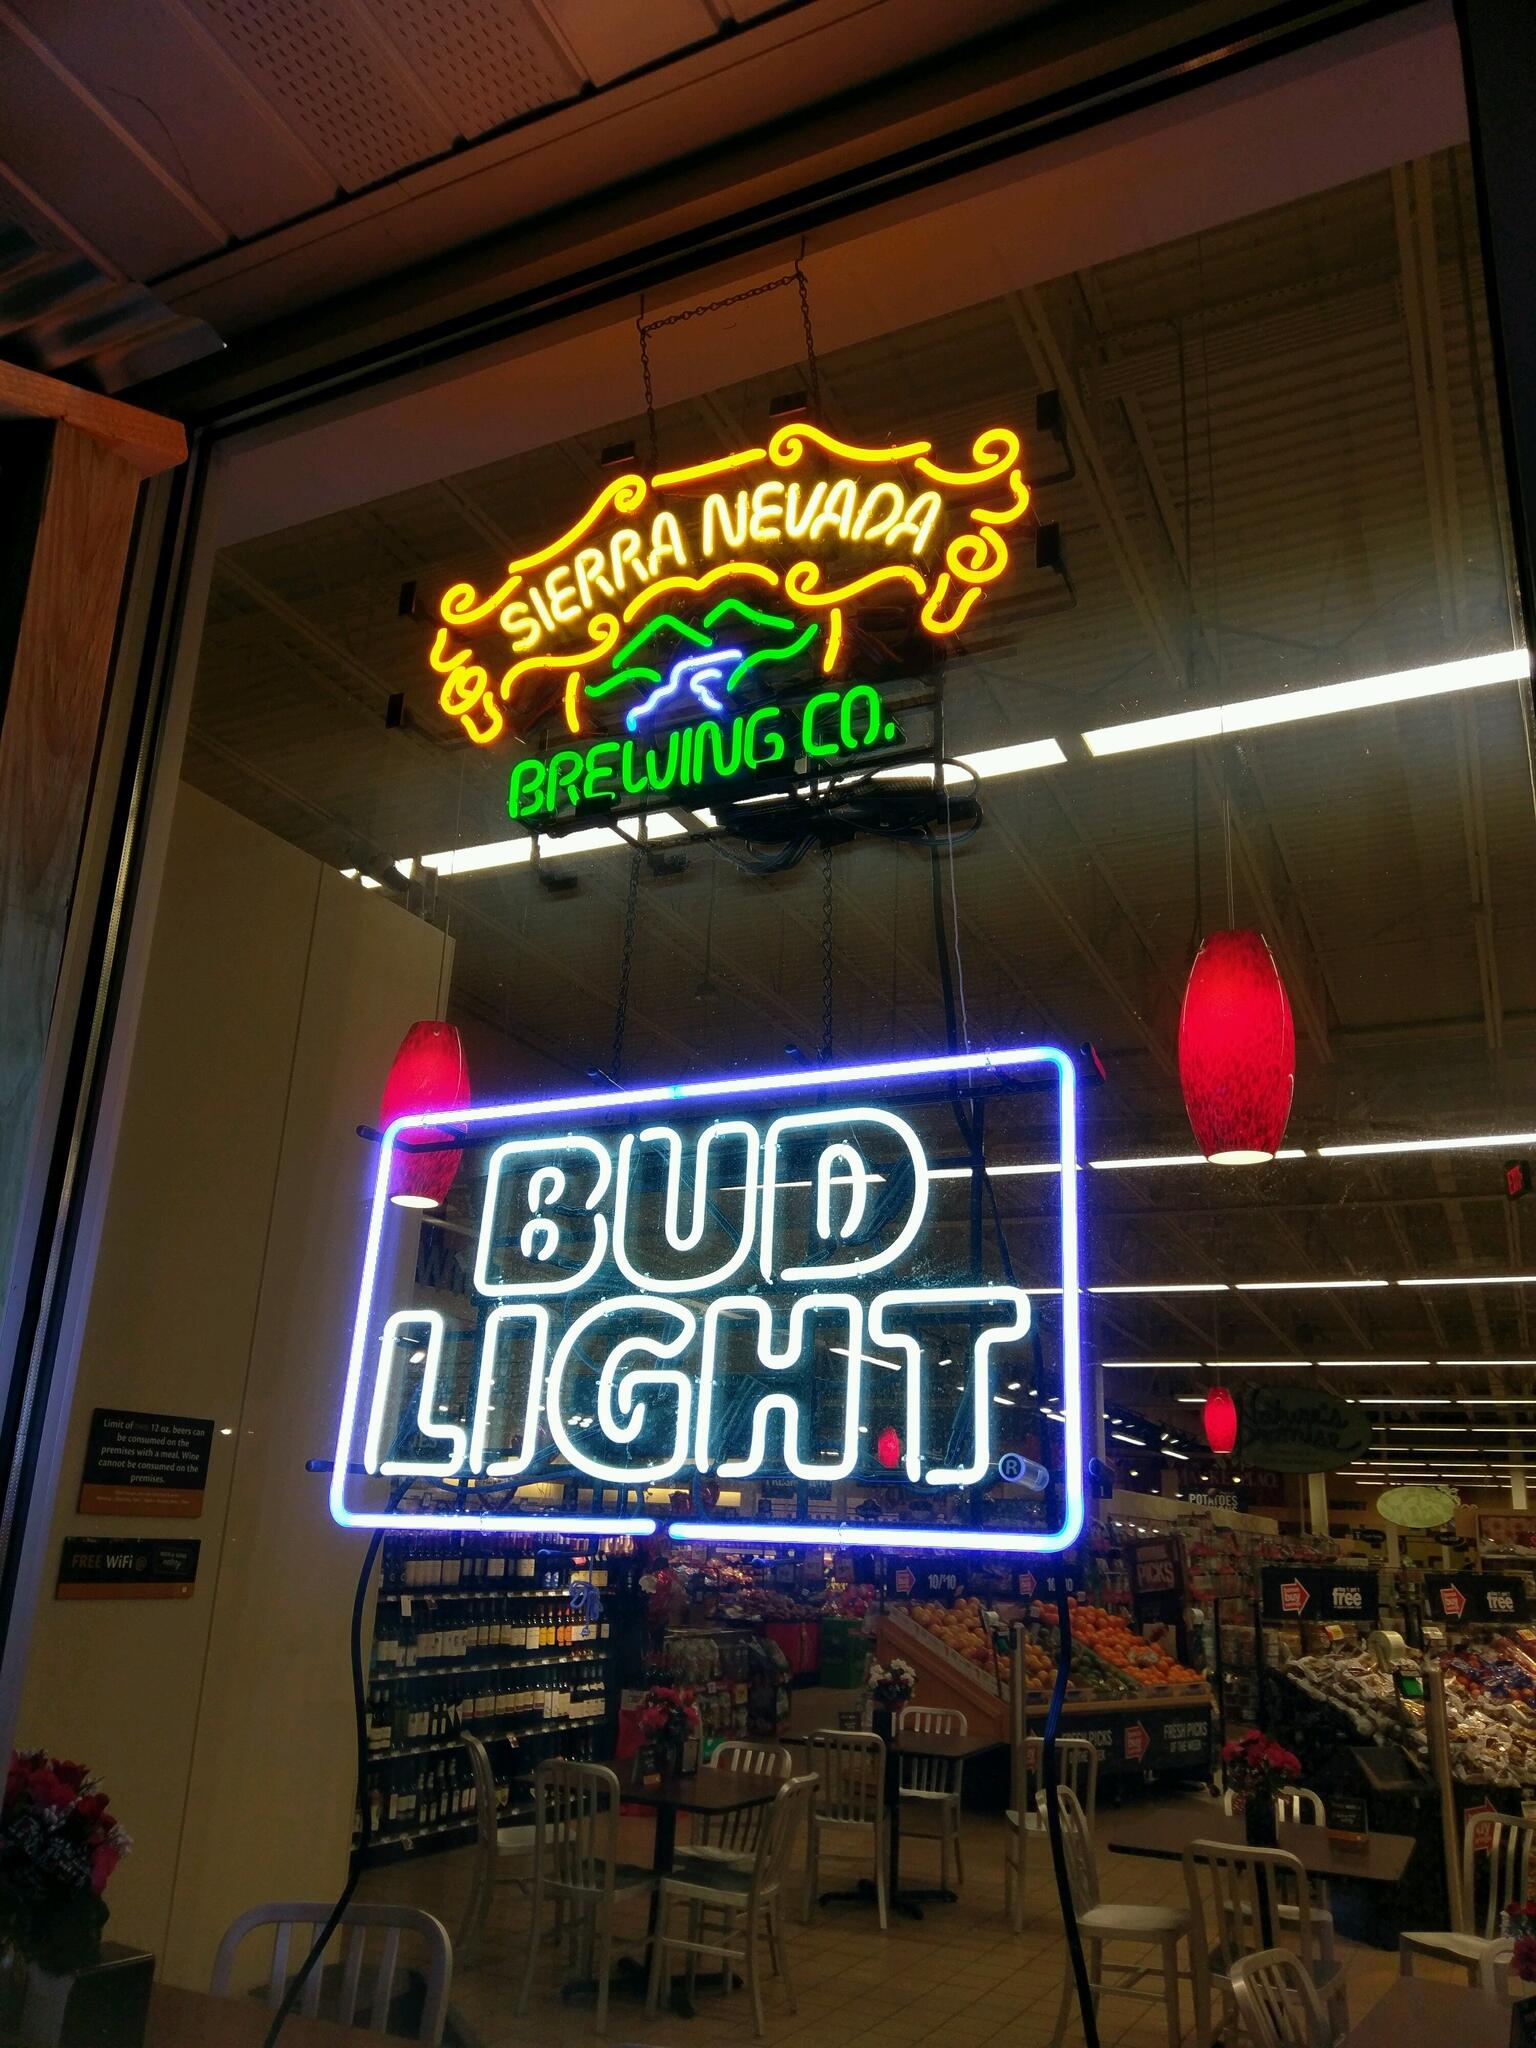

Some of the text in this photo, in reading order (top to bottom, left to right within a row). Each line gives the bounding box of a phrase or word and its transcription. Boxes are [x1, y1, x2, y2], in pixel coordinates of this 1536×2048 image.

[500, 478, 943, 652] SIERRA NEVADA
[508, 685, 896, 819] BREWING CO.
[472, 1107, 930, 1298] BUD
[364, 1285, 1032, 1486] LIGHT
[103, 1418, 124, 1430] Limit
[125, 1420, 134, 1430] of
[151, 1424, 159, 1432] 12
[172, 1425, 192, 1435] beers
[193, 1429, 205, 1437] can
[117, 1433, 127, 1442] be
[128, 1435, 165, 1446] consumed
[177, 1438, 189, 1447] the
[101, 1446, 135, 1458] premises
[137, 1447, 154, 1458] with
[182, 1450, 200, 1461] Wine
[98, 1459, 199, 1473] cannot be consumed on the
[130, 1474, 165, 1484] premises.
[1189, 1493, 1239, 1506] POTATOES
[72, 1554, 102, 1569] FREE
[106, 1554, 134, 1569] WiFi
[1136, 1561, 1175, 1587] PICKS
[1332, 1587, 1362, 1607] free
[1486, 1592, 1514, 1610] free
[1187, 1721, 1208, 1737] PICKS
